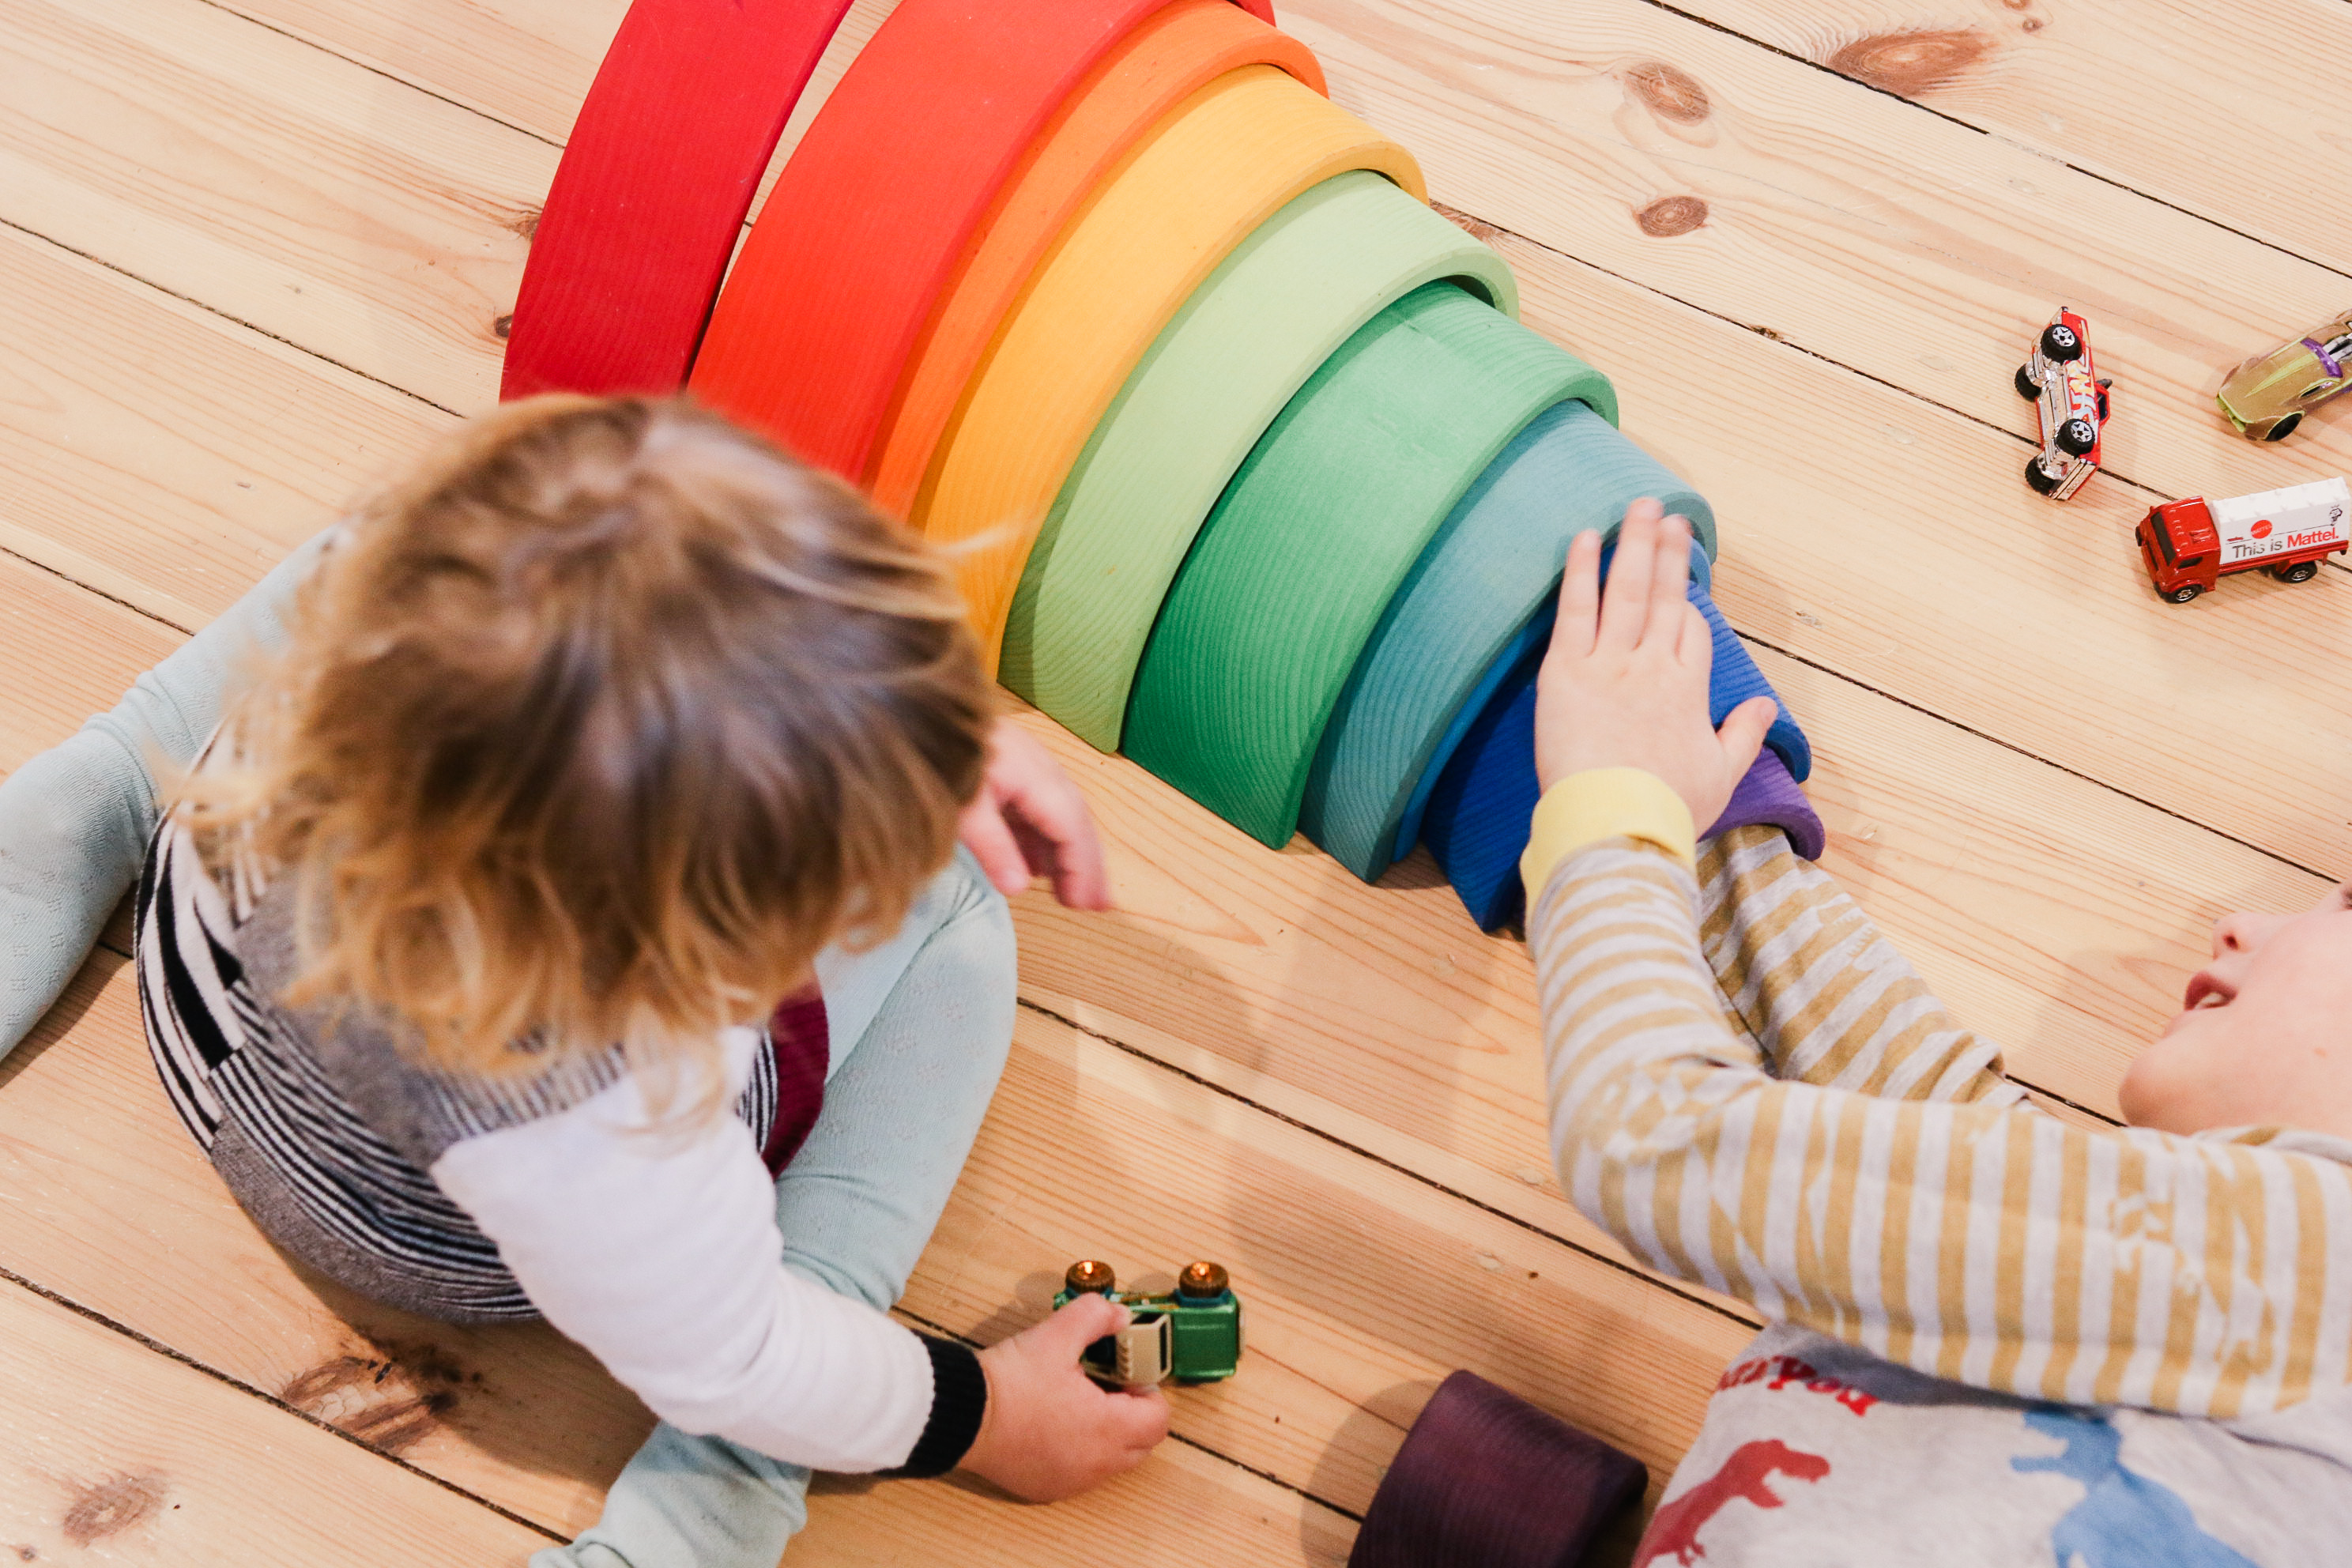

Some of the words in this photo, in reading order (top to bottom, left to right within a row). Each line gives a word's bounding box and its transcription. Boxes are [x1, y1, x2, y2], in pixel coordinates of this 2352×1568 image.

[2232, 542, 2265, 559] This
[2270, 539, 2282, 552] is
[2287, 527, 2339, 548] Mattel.
